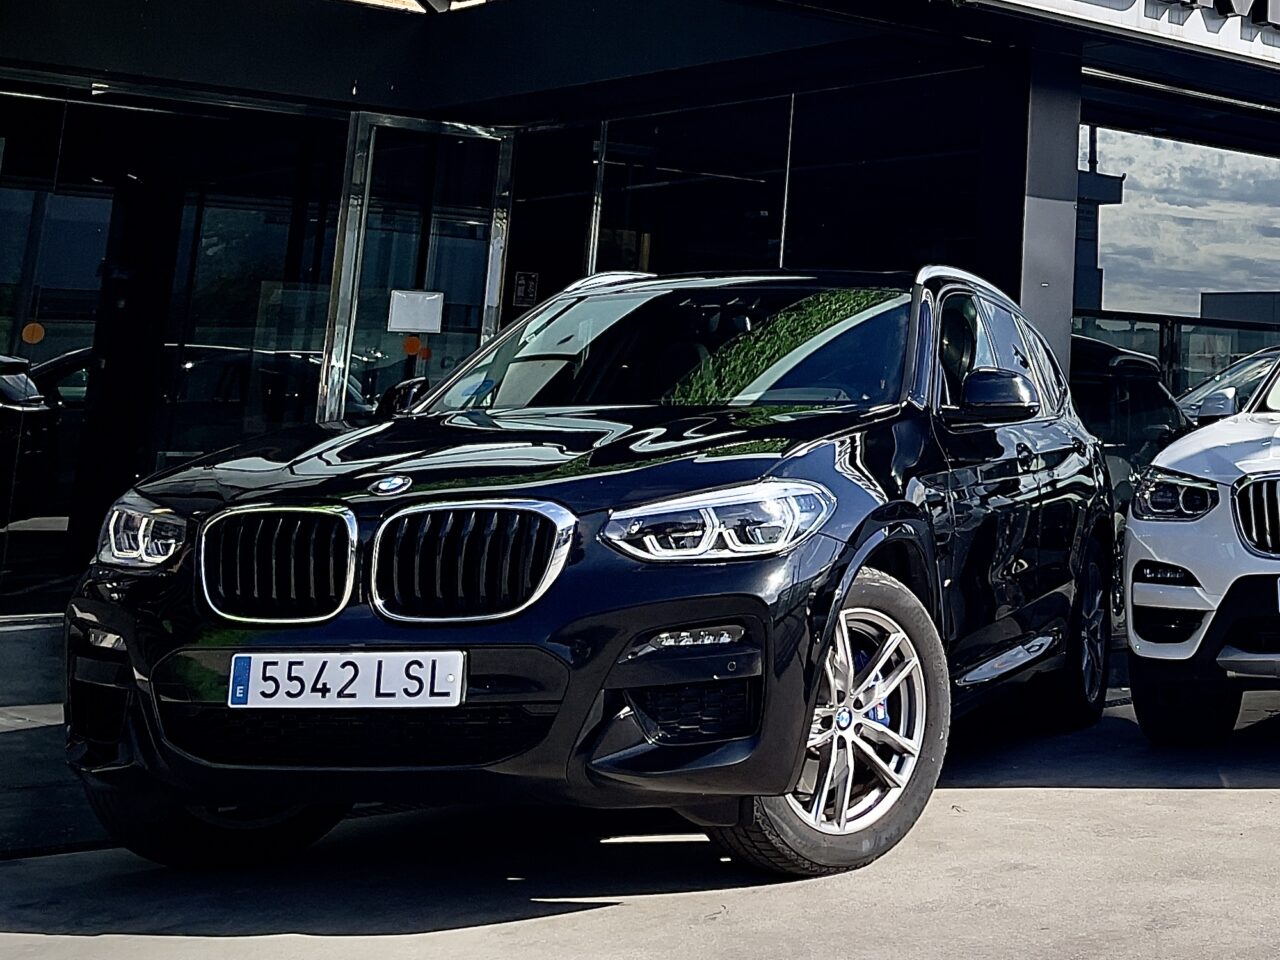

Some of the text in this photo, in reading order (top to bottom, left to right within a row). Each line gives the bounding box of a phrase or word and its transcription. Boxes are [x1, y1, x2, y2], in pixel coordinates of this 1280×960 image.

[235, 658, 451, 699] E 5542 LSL
